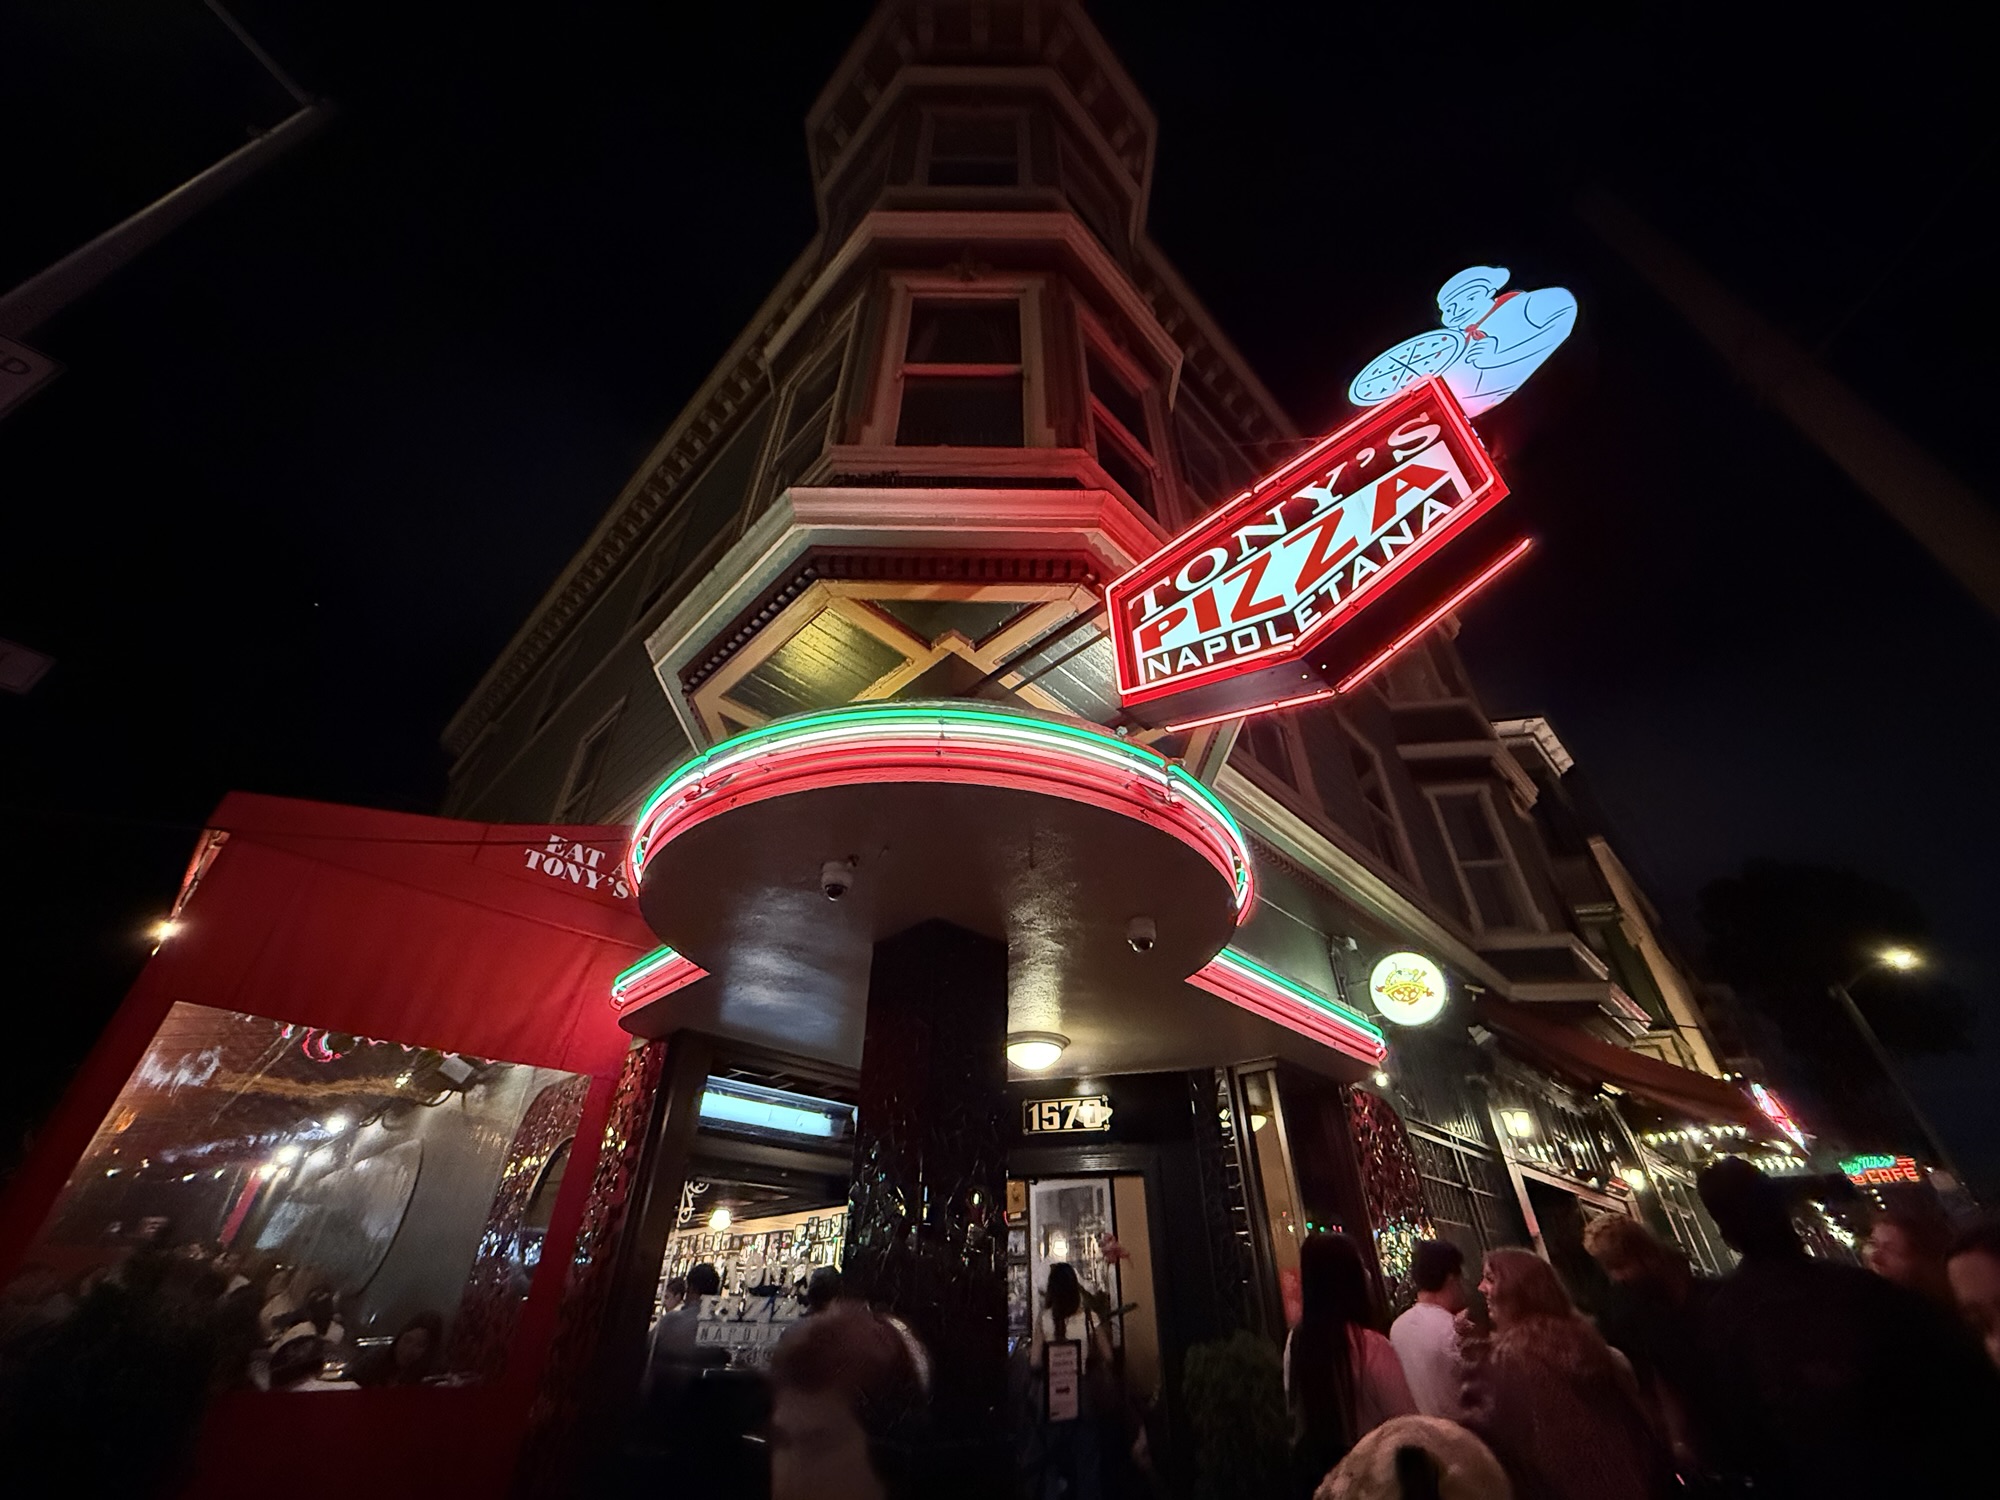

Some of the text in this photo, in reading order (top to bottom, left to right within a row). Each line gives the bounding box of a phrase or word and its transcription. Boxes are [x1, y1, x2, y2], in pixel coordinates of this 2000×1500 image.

[1127, 411, 1441, 622] TONY'S
[1139, 463, 1450, 653] PIZZA
[1147, 498, 1454, 681] NAPOLETANA
[524, 848, 630, 900] TONY'S
[545, 834, 606, 869] EAT
[1028, 1099, 1103, 1131] 1570
[1865, 1167, 1919, 1184] CAFE
